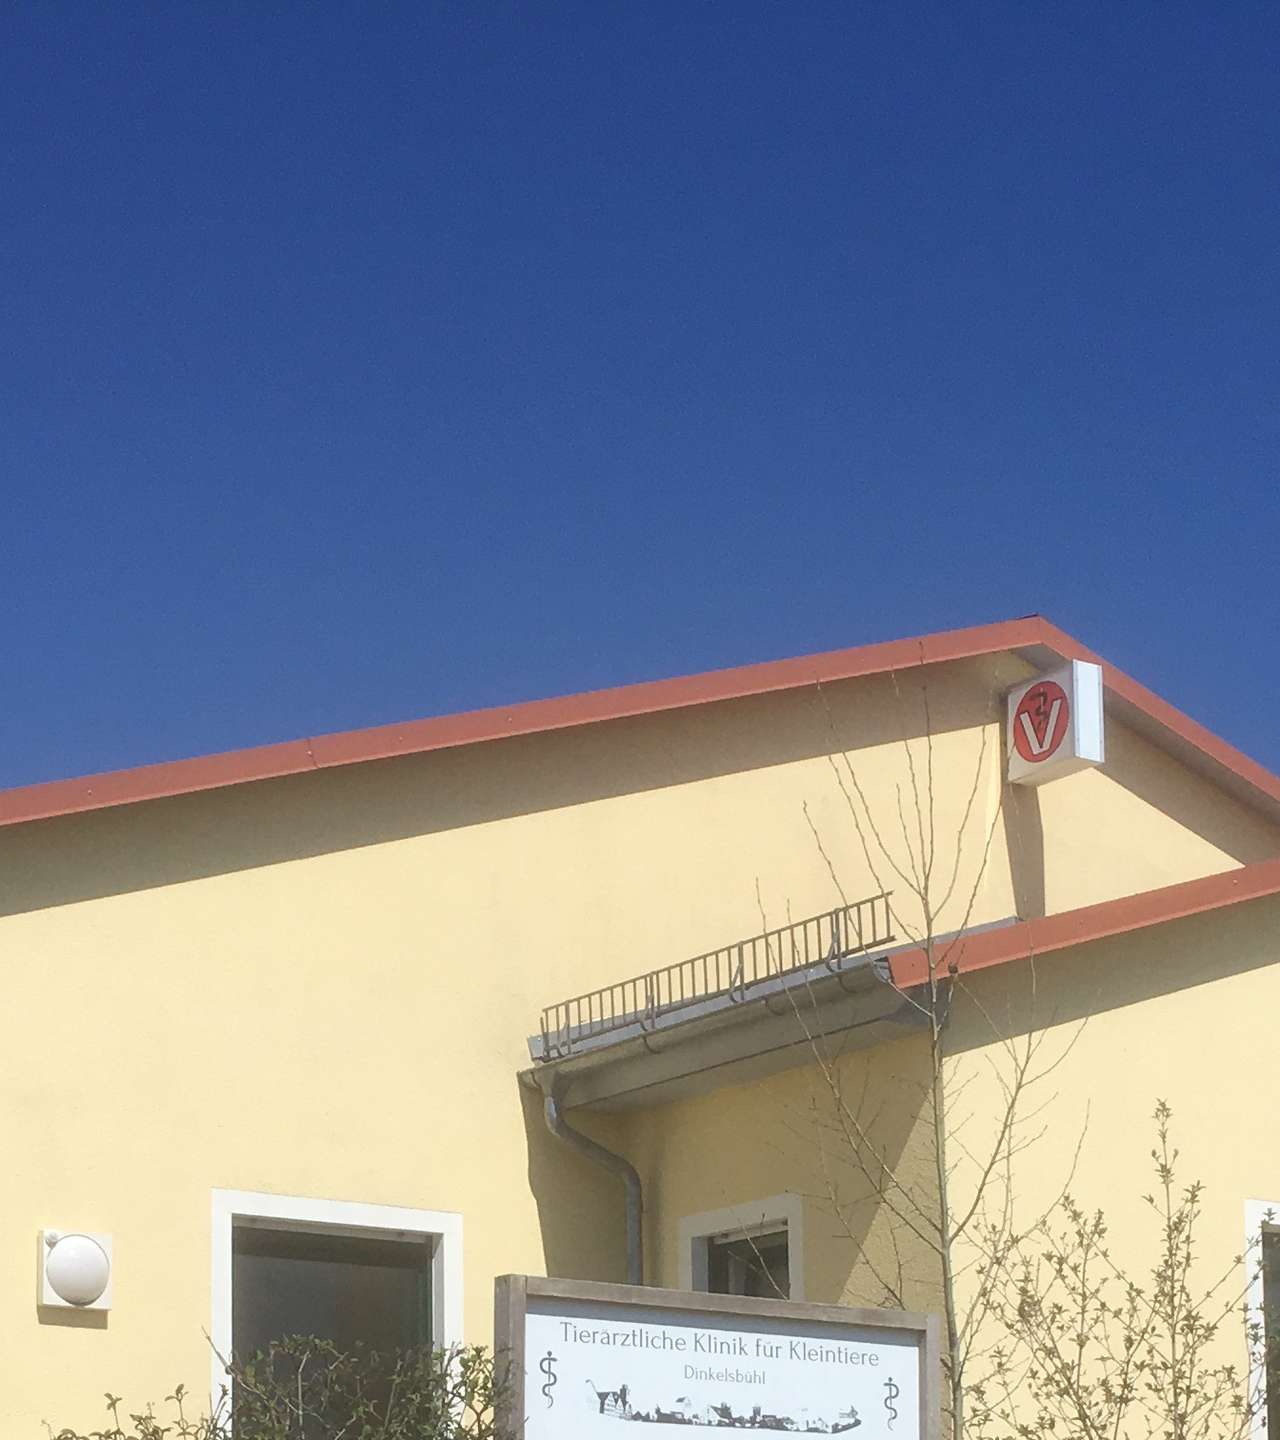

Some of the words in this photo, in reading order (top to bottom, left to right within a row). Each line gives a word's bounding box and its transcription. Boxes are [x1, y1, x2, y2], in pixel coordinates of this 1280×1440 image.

[559, 1321, 687, 1351] Tierärztliche
[694, 1332, 748, 1357] Klinik
[755, 1338, 782, 1359] für
[789, 1340, 880, 1367] Kleintiere
[683, 1364, 766, 1385] Dinkelsbühl
